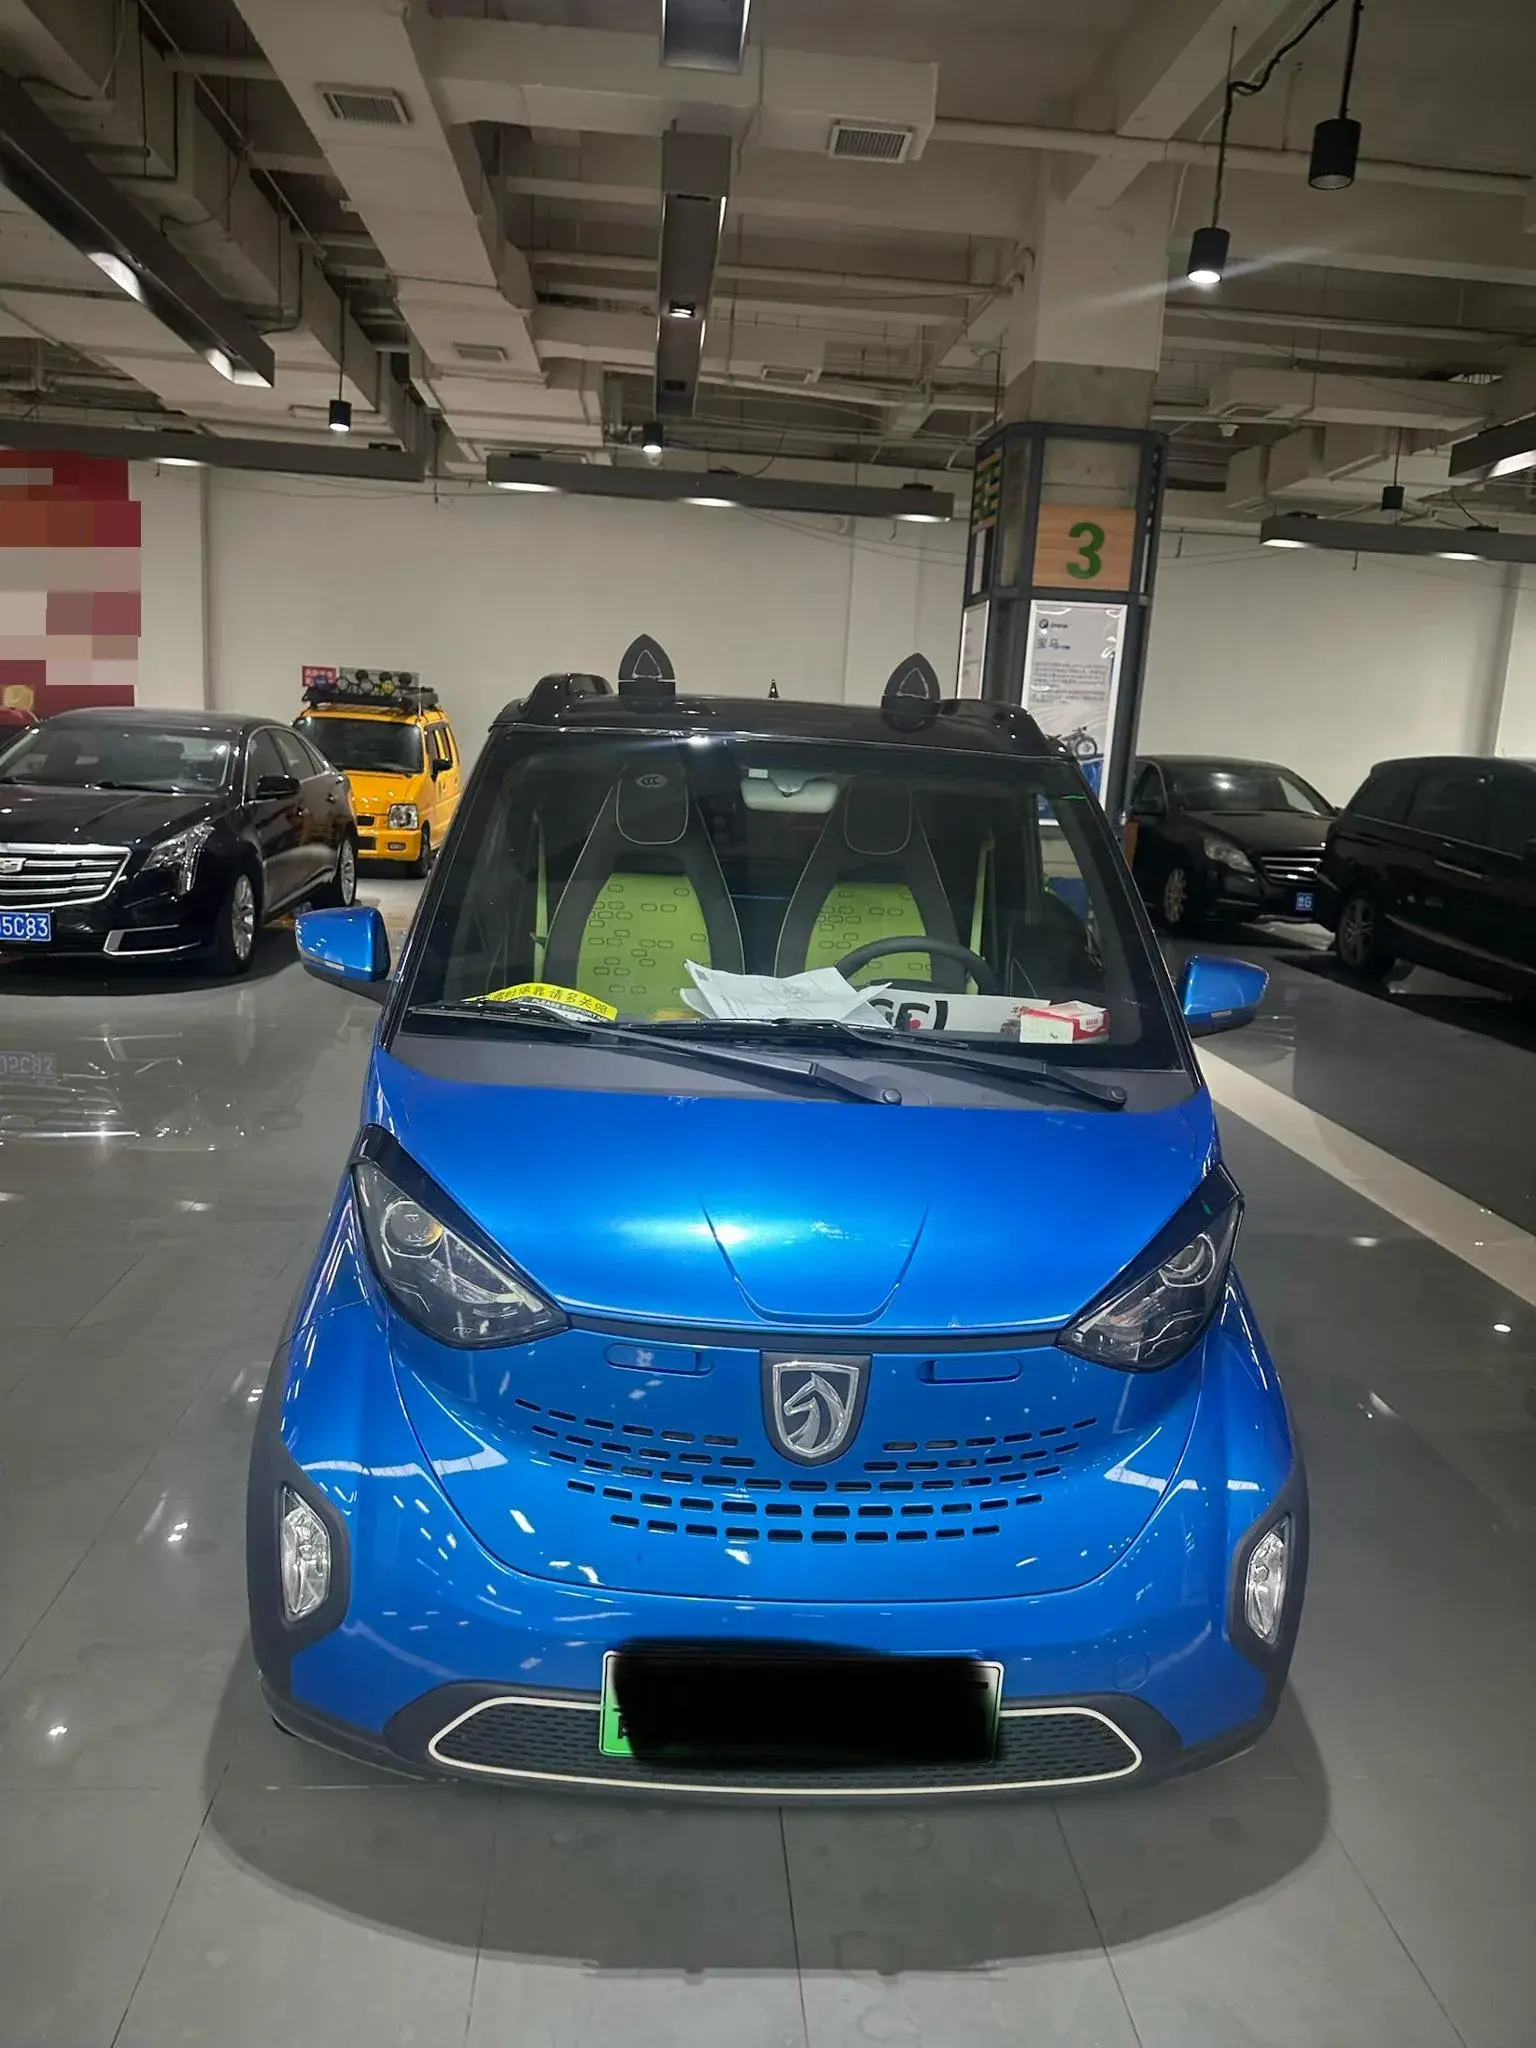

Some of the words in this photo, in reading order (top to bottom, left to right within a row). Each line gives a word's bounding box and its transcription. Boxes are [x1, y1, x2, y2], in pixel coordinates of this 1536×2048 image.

[1066, 521, 1105, 579] 3
[0, 916, 48, 937] 5C83
[531, 998, 561, 1009] PLEASE
